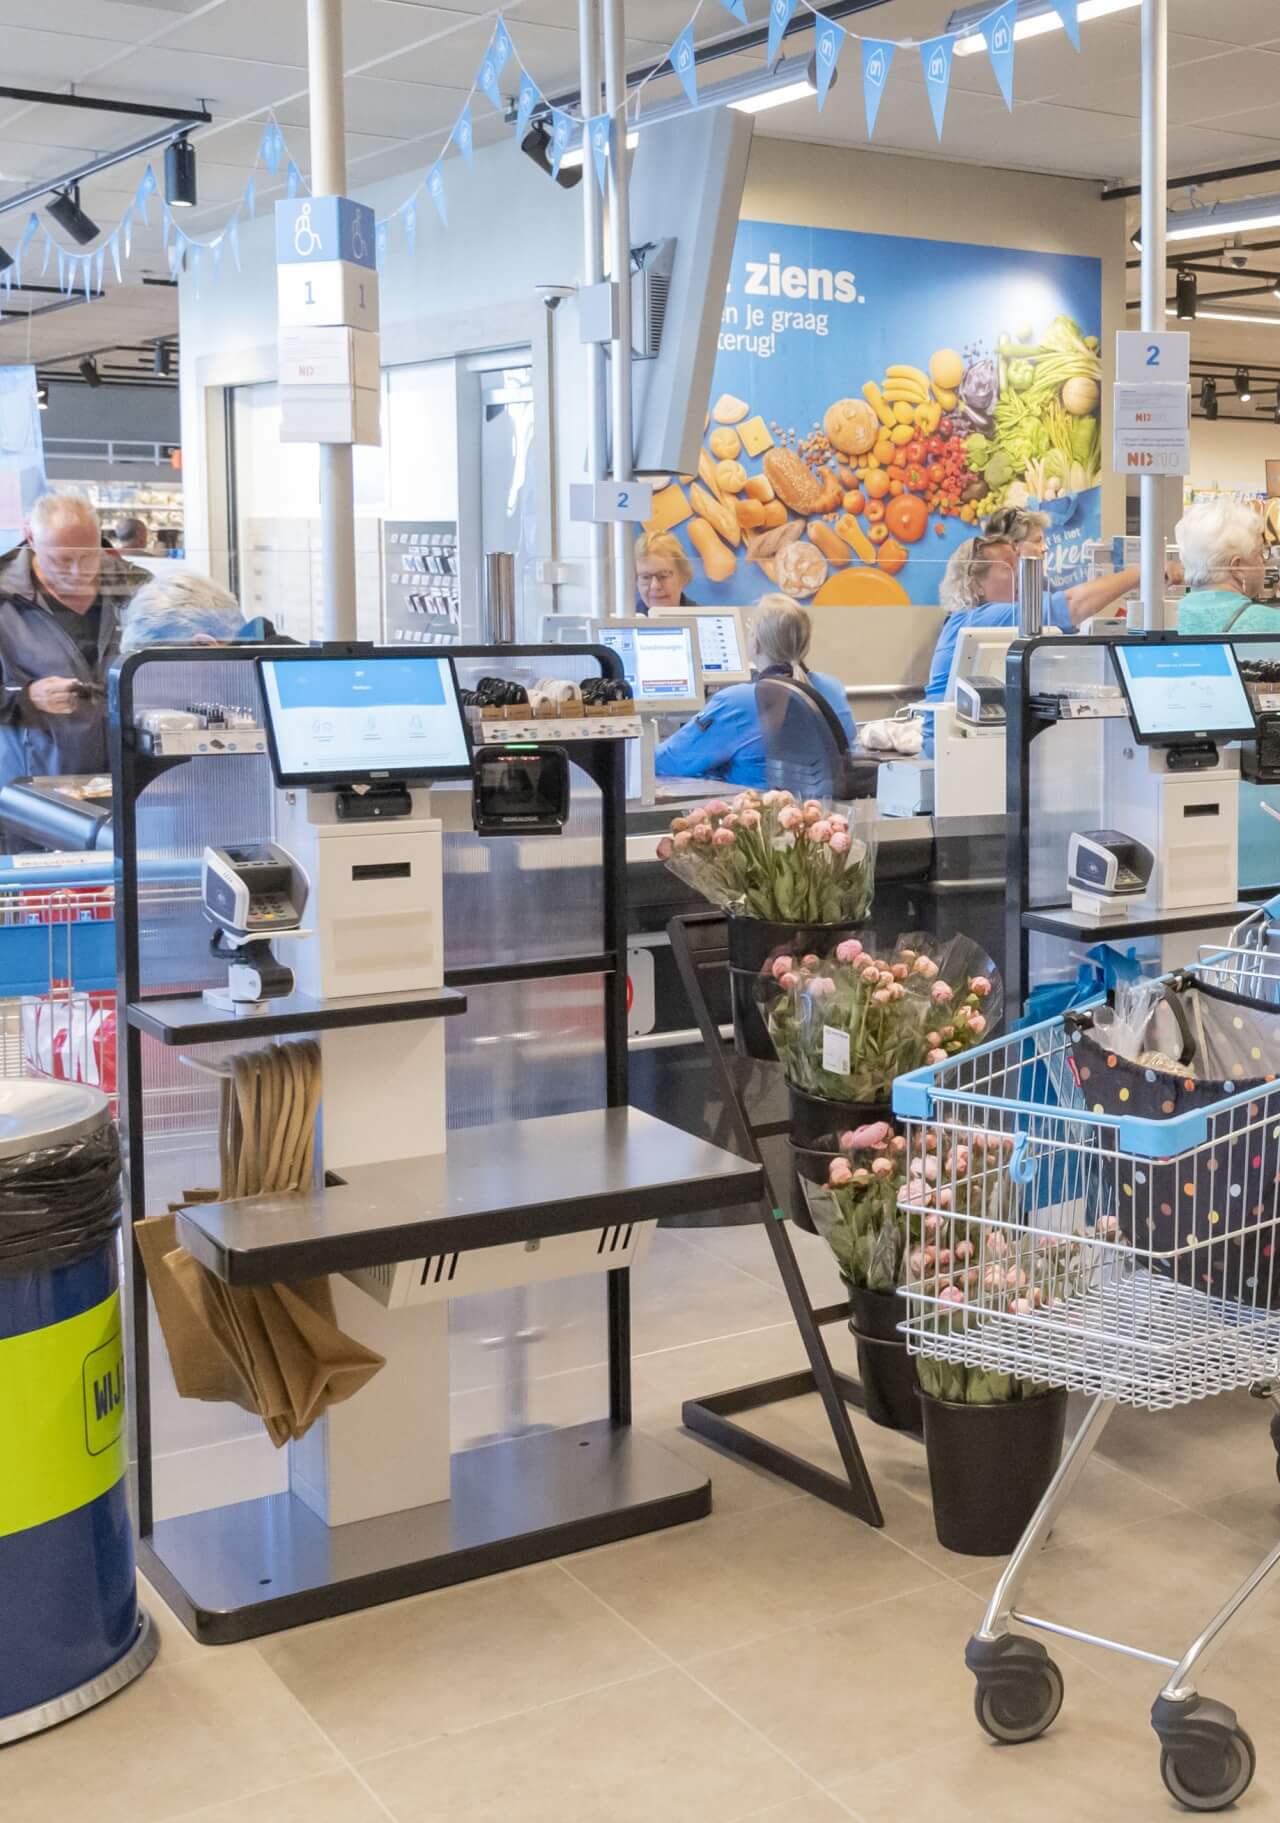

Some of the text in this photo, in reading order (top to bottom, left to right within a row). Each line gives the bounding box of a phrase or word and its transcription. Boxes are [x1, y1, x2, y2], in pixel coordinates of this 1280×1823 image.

[744, 252, 865, 304] ziens.
[305, 281, 315, 304] 1
[358, 284, 366, 309] 1
[745, 304, 764, 330] je
[771, 310, 829, 336] graag
[717, 332, 776, 358] terug!
[1146, 345, 1160, 366] 2
[617, 492, 629, 508] 2
